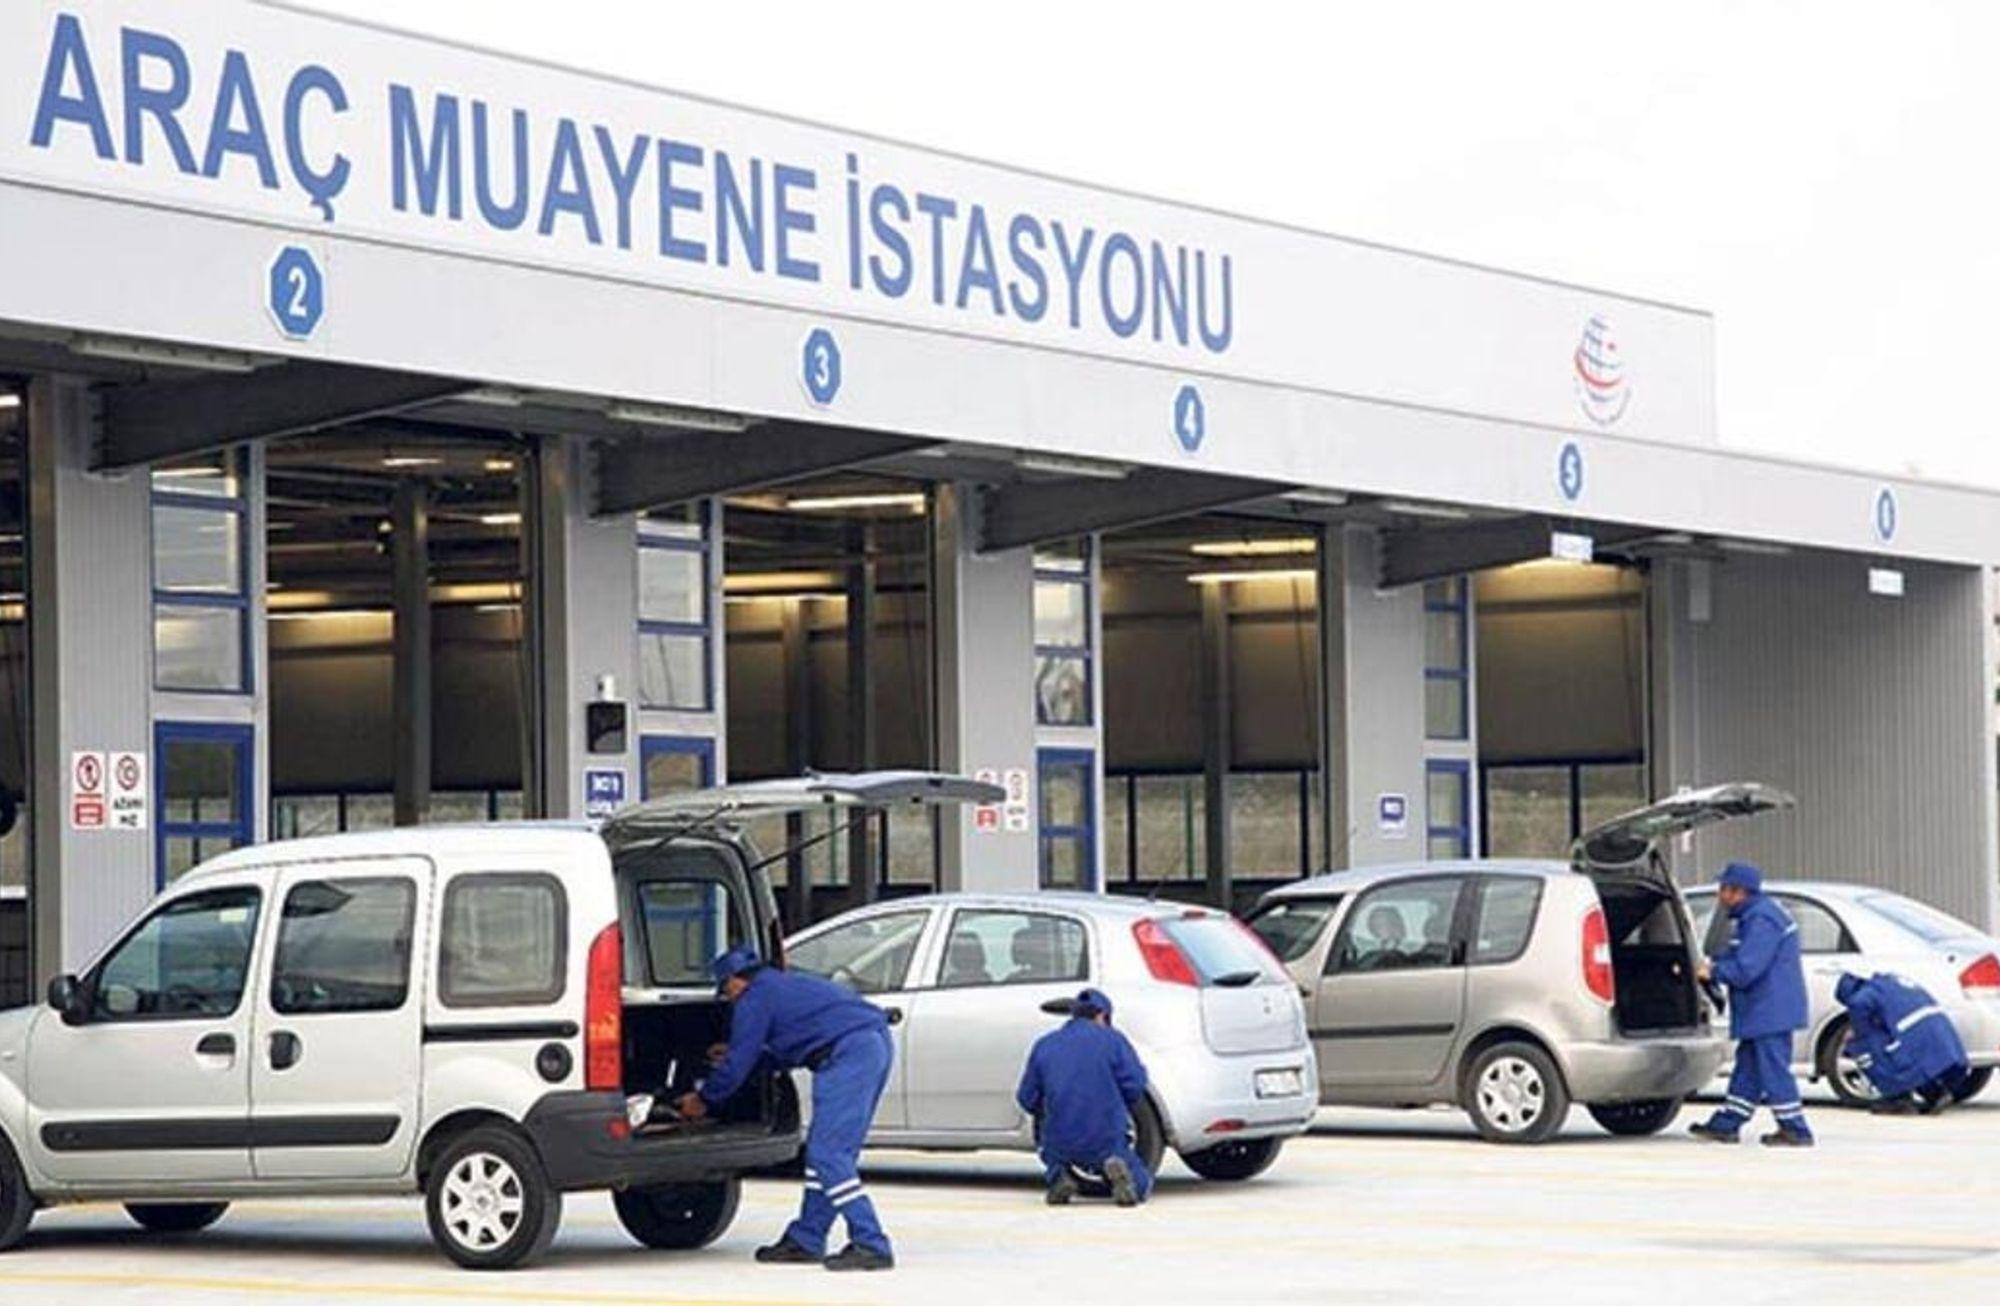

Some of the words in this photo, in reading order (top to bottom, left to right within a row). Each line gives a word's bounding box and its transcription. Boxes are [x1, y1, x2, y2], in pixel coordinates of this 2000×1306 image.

[31, 13, 350, 222] ARAÇ
[389, 84, 820, 282] MUAYENE
[847, 153, 1232, 354] İSTASYONU
[288, 265, 307, 316] 2
[815, 345, 829, 388] 3
[1183, 399, 1196, 438] 4
